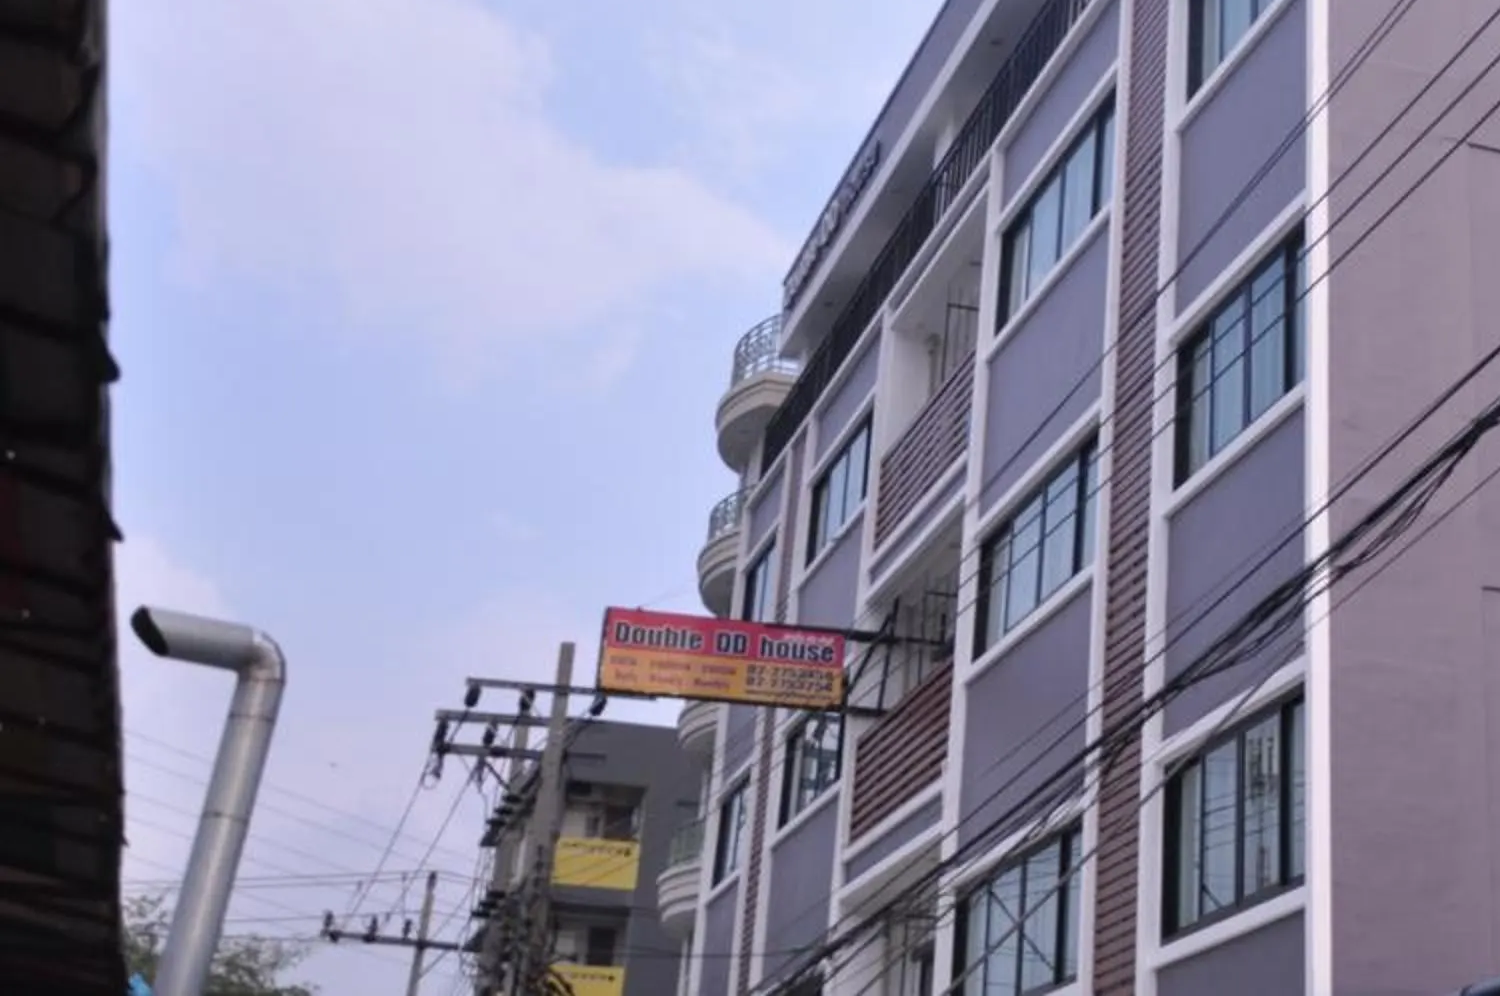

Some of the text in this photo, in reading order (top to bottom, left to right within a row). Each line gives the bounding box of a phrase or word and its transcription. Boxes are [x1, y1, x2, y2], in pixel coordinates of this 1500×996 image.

[614, 621, 703, 650] Double
[716, 631, 748, 655] DD
[760, 633, 835, 663] house
